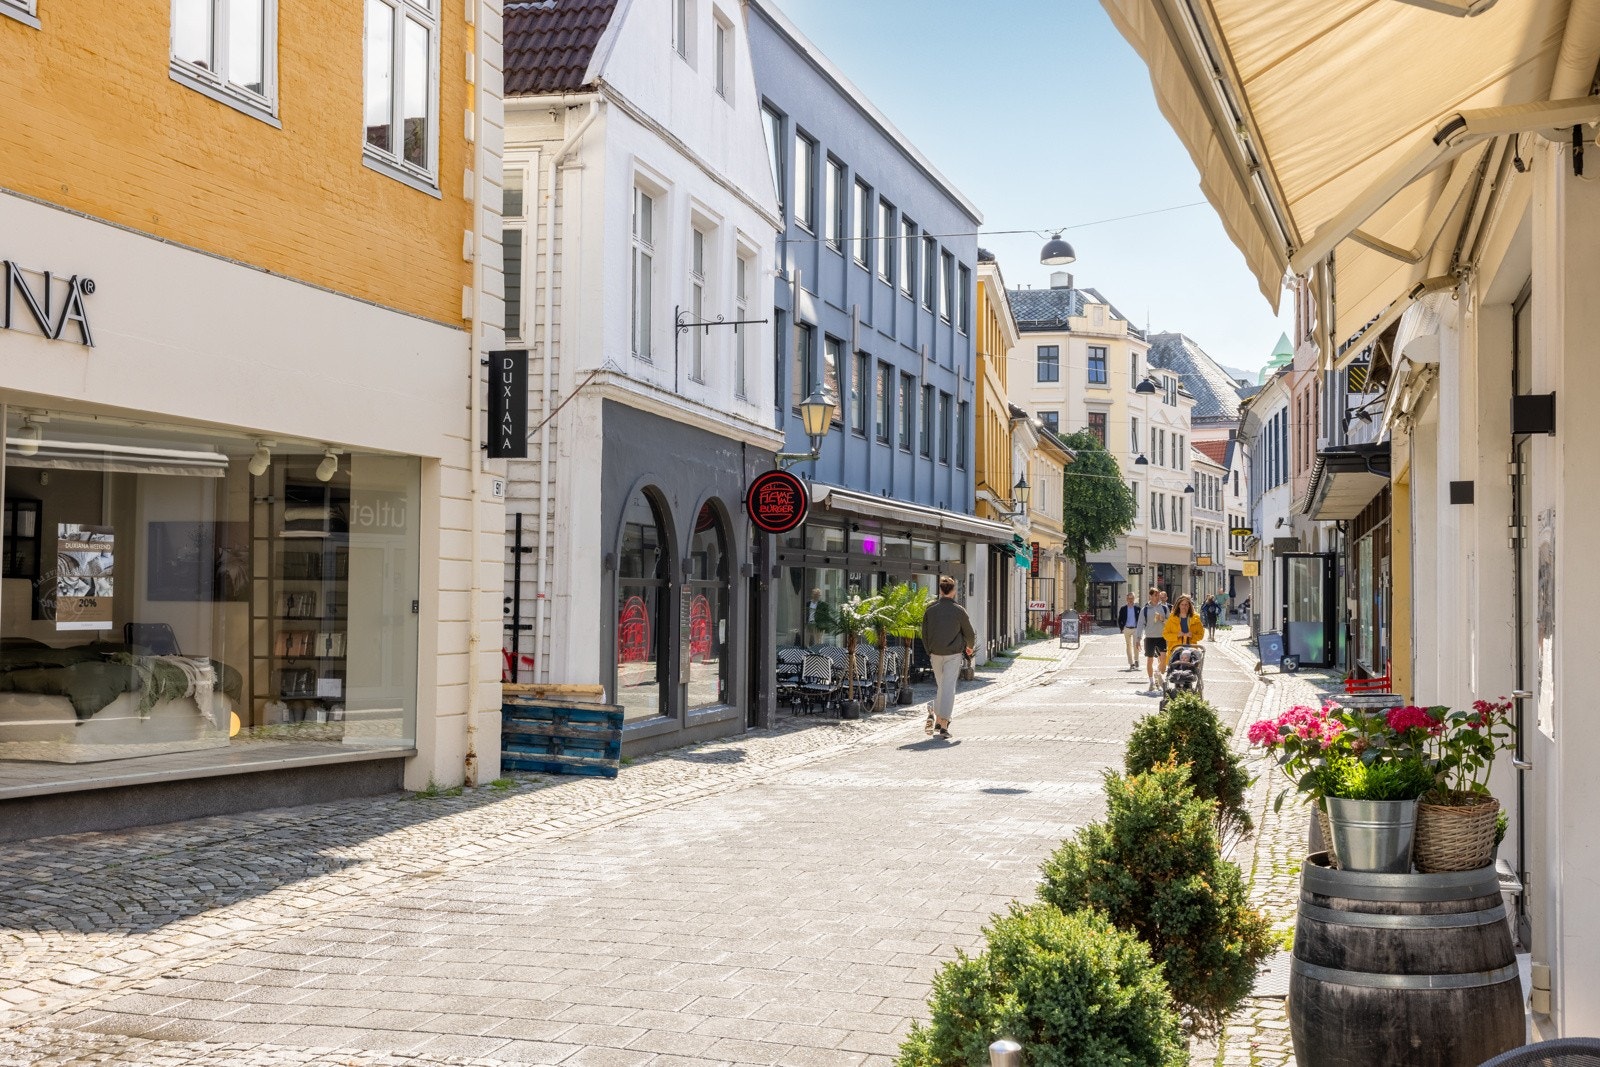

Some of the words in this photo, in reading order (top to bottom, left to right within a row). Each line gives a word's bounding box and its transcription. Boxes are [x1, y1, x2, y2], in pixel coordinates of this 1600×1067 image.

[502, 358, 514, 449] DUXIANA
[759, 504, 794, 513] BURGER
[79, 598, 97, 608] 20%
